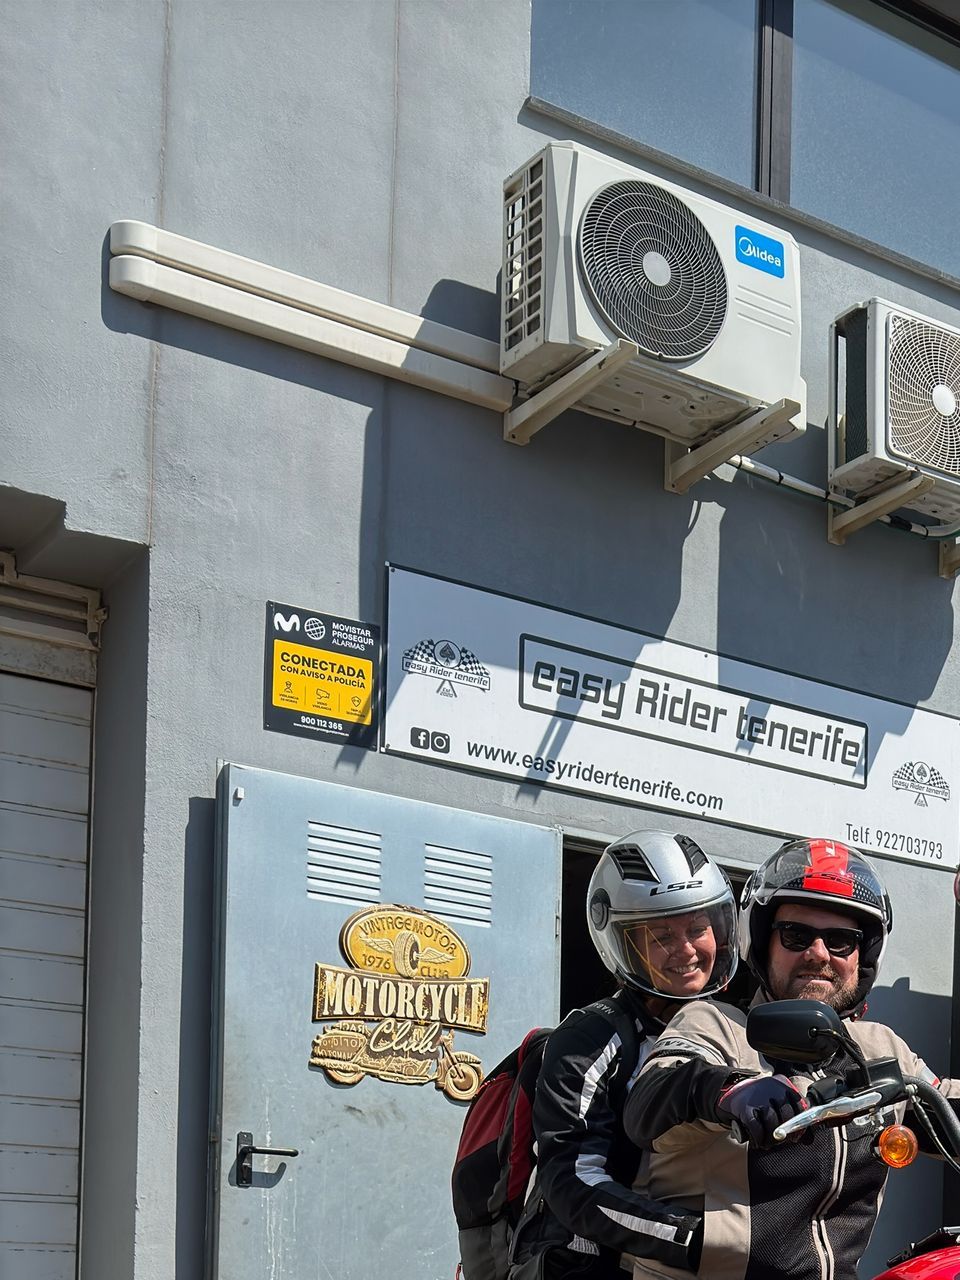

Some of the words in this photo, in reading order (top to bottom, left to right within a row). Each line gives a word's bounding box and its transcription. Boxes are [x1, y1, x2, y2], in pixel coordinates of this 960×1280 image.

[739, 236, 781, 267] Midea
[332, 622, 371, 637] MOVISTAR
[332, 631, 374, 646] PROSEGUR
[331, 638, 365, 651] ALARMAS
[280, 652, 366, 679] CONECTADA
[280, 665, 299, 675] CON
[300, 669, 325, 680] AVISO
[327, 674, 333, 682] A
[334, 675, 366, 689] POLICÍA
[405, 661, 427, 673] easy
[429, 666, 453, 677] Rider
[454, 671, 488, 686] tenerife
[300, 715, 316, 725] 900
[316, 718, 328, 728] 112
[328, 721, 343, 731] 365
[532, 661, 626, 720] easy
[635, 678, 728, 733] Rider
[736, 704, 860, 768] tenerife
[466, 740, 724, 811] www.easyridertenerife.com
[846, 823, 872, 846] Telf.
[876, 829, 943, 860] 922703793
[650, 880, 703, 896] LS2
[362, 953, 391, 970] 1976
[322, 970, 485, 1028] MOTORCYCLE
[369, 1018, 442, 1053] Club
